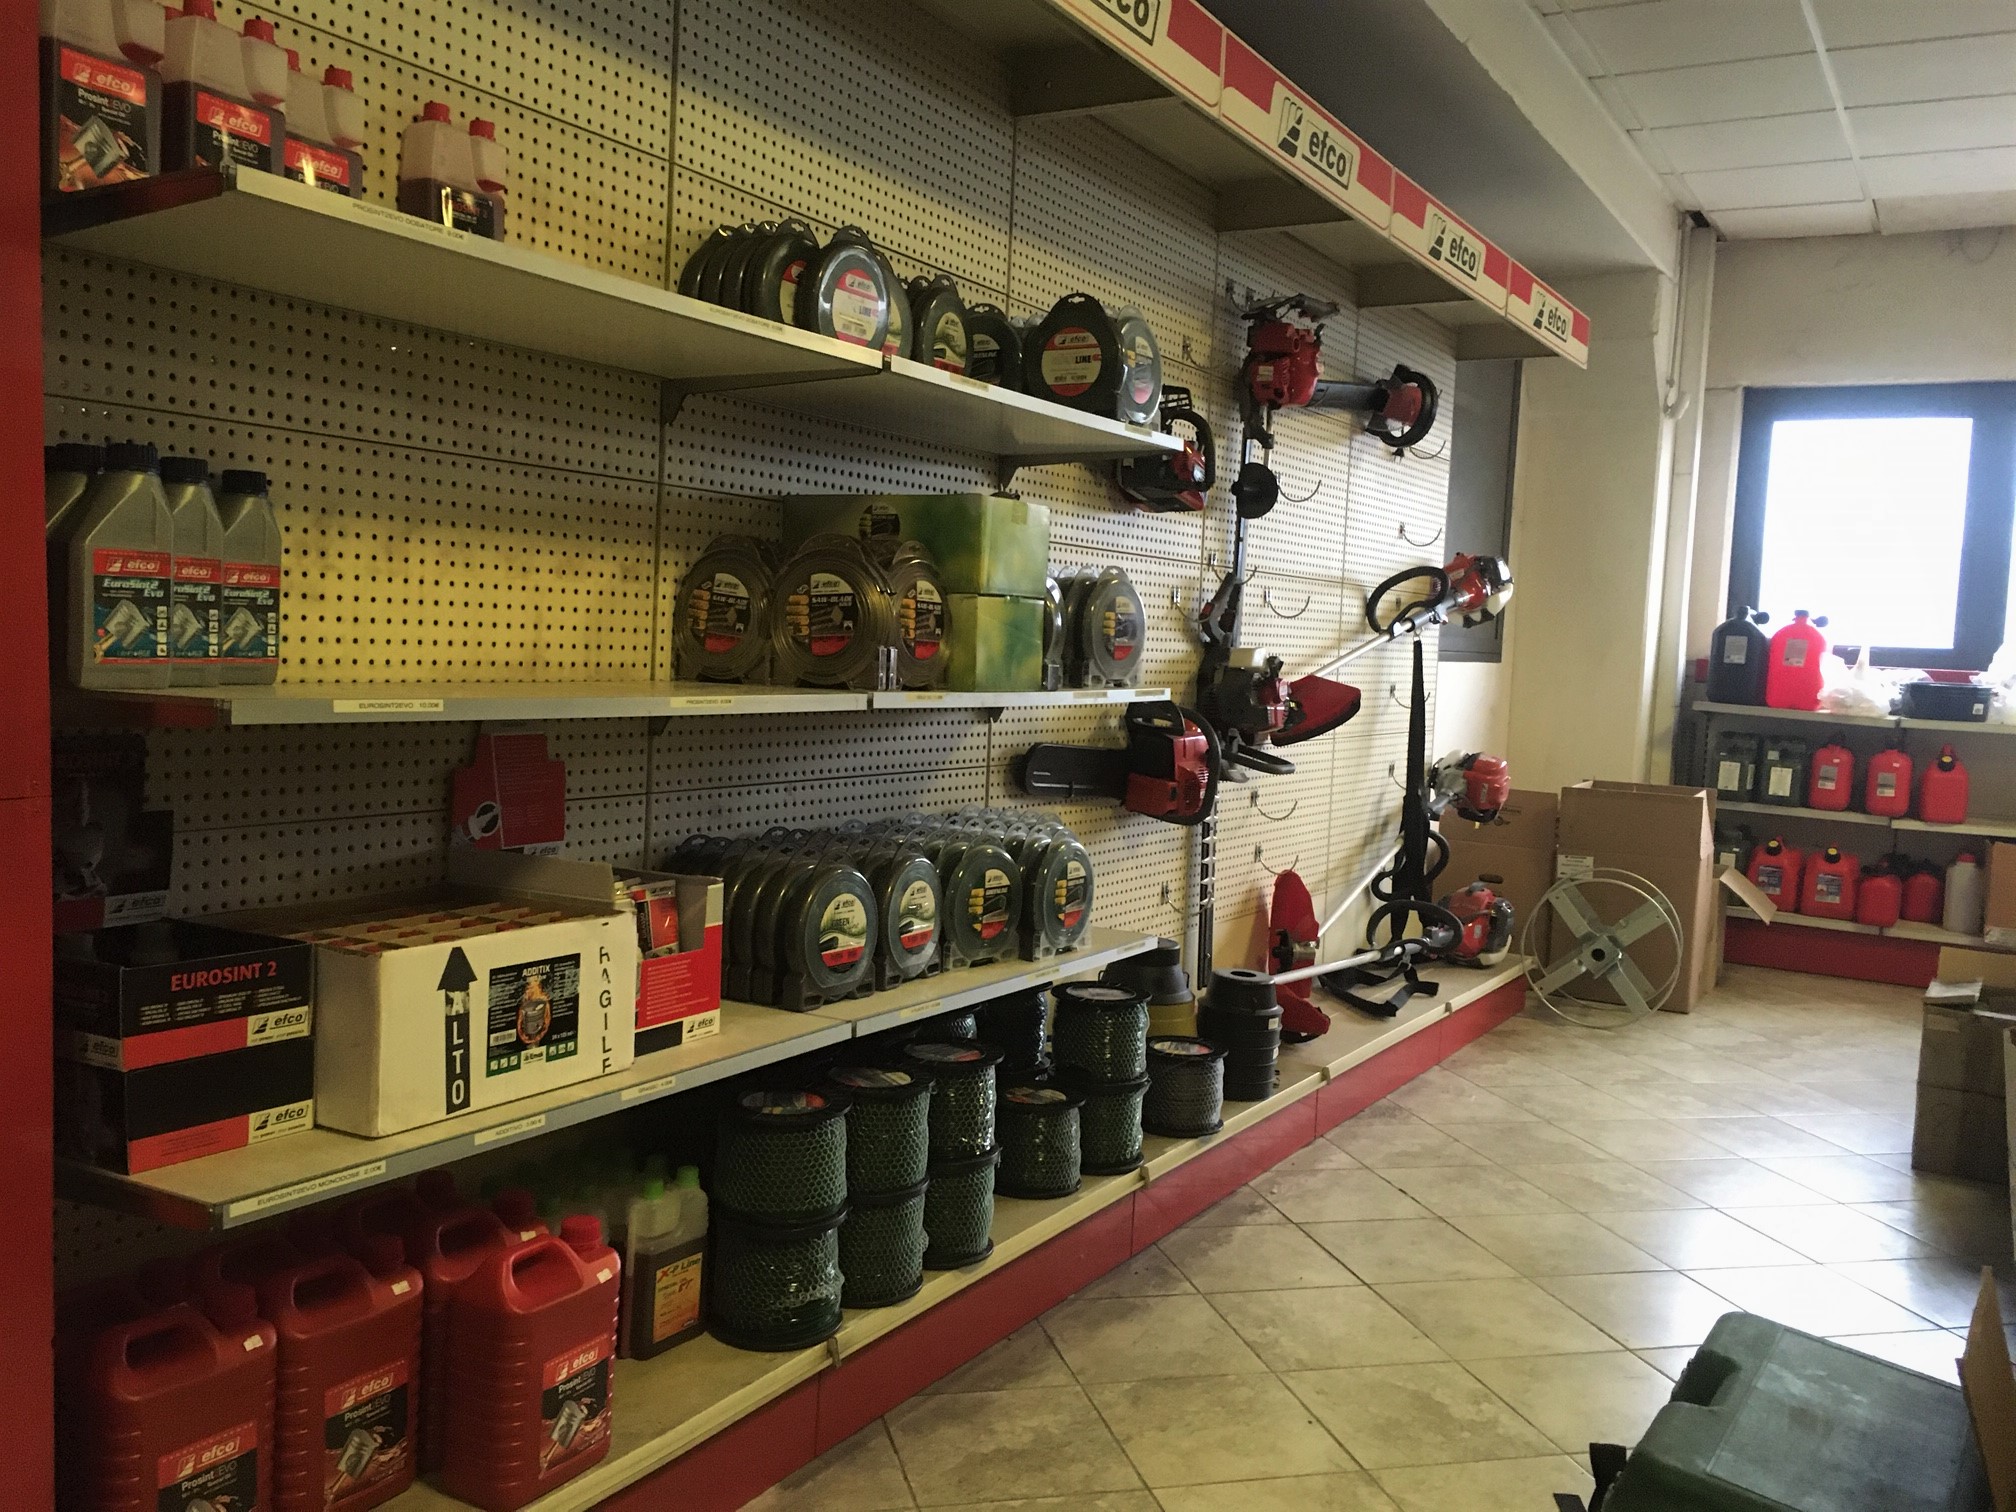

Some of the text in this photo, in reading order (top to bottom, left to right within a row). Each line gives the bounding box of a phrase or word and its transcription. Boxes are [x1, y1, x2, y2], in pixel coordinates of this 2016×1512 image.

[96, 74, 130, 92] efco
[229, 116, 258, 133] efco
[1309, 131, 1346, 177] efco
[1450, 235, 1476, 272] efco
[1549, 307, 1566, 335] efco
[1075, 355, 1091, 364] LINE
[127, 559, 156, 571] efco
[181, 566, 208, 577] efco
[242, 572, 267, 582] efco
[143, 588, 165, 598] Evo
[540, 847, 557, 855] efco
[170, 960, 278, 992] EUROSINT 2
[522, 964, 551, 977] ADDITIX
[274, 1012, 303, 1027] efco
[697, 1018, 713, 1028] efco
[452, 992, 465, 1105] ALTO
[275, 1107, 304, 1122] efco
[318, 1171, 360, 1188] MONODOSE
[681, 1257, 701, 1270] Line
[573, 1350, 595, 1369] efco
[361, 1376, 389, 1395] efco
[344, 1402, 372, 1422] Prosint
[201, 1441, 235, 1463] efco
[181, 1470, 215, 1492] Prosint
